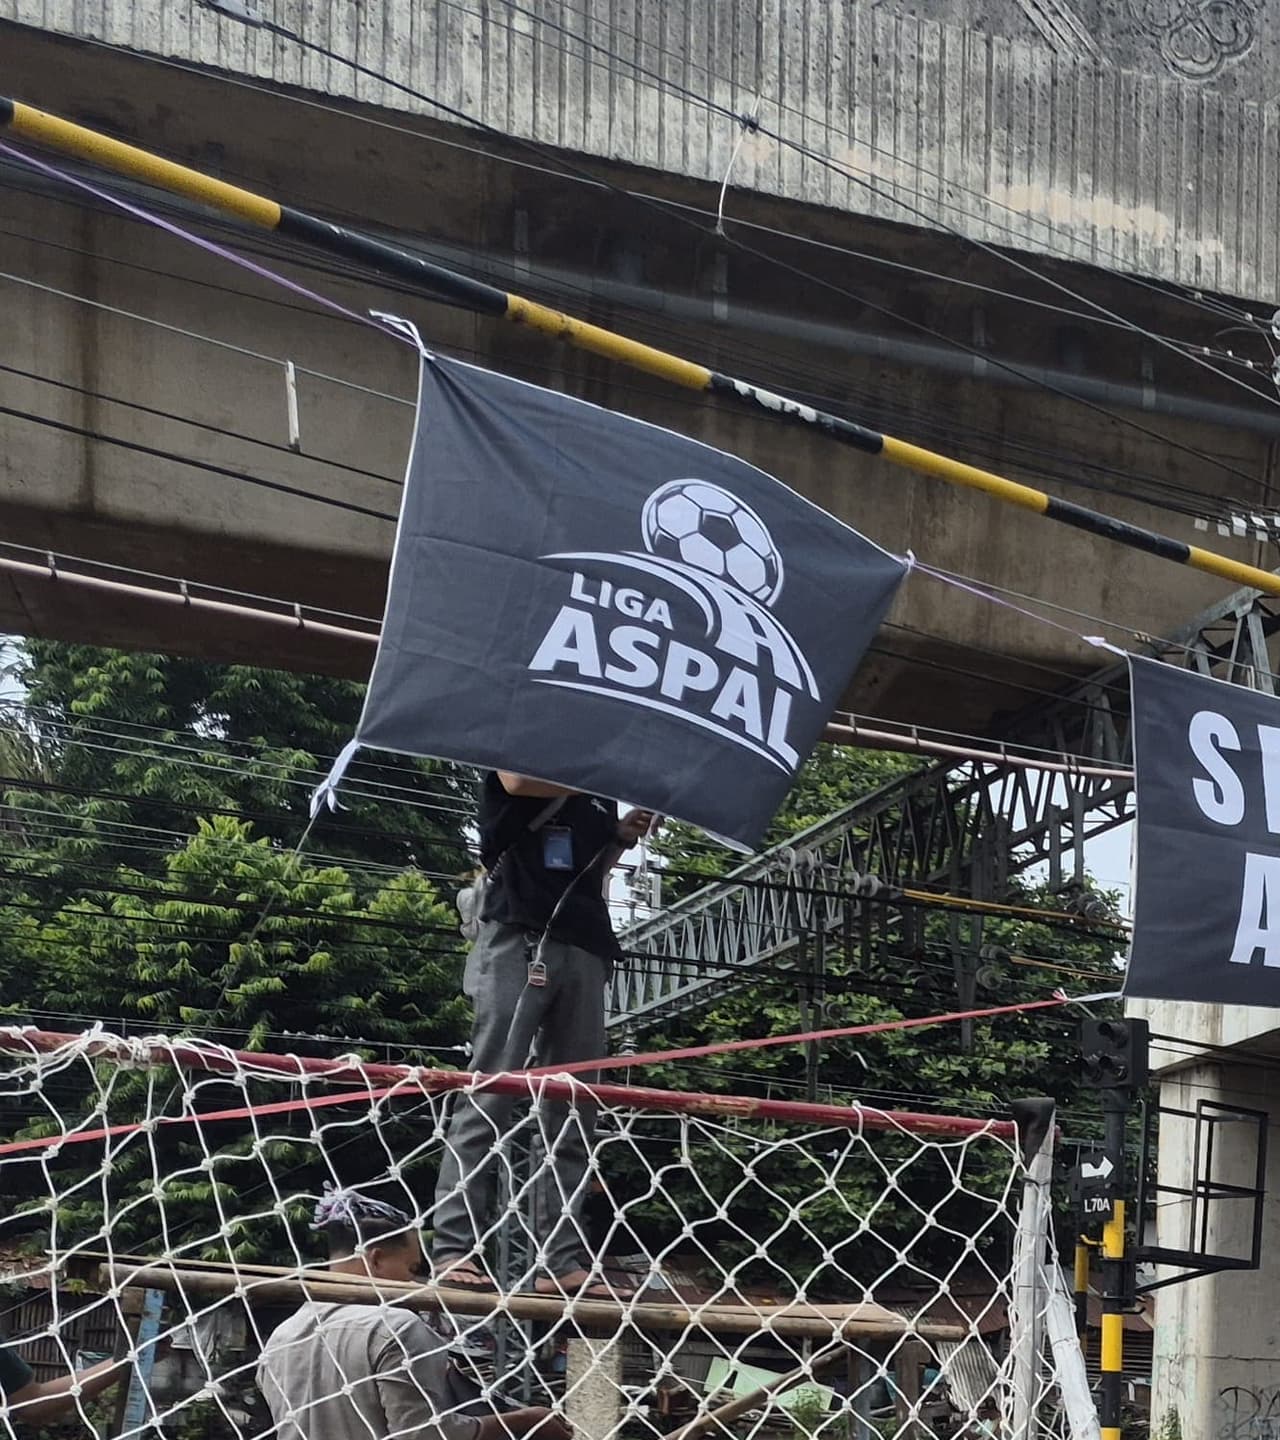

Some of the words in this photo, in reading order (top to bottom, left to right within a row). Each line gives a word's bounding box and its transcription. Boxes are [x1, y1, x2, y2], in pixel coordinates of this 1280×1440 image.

[570, 573, 673, 631] LIGA
[529, 606, 799, 770] ASPAL
[1084, 1197, 1111, 1213] L70A
